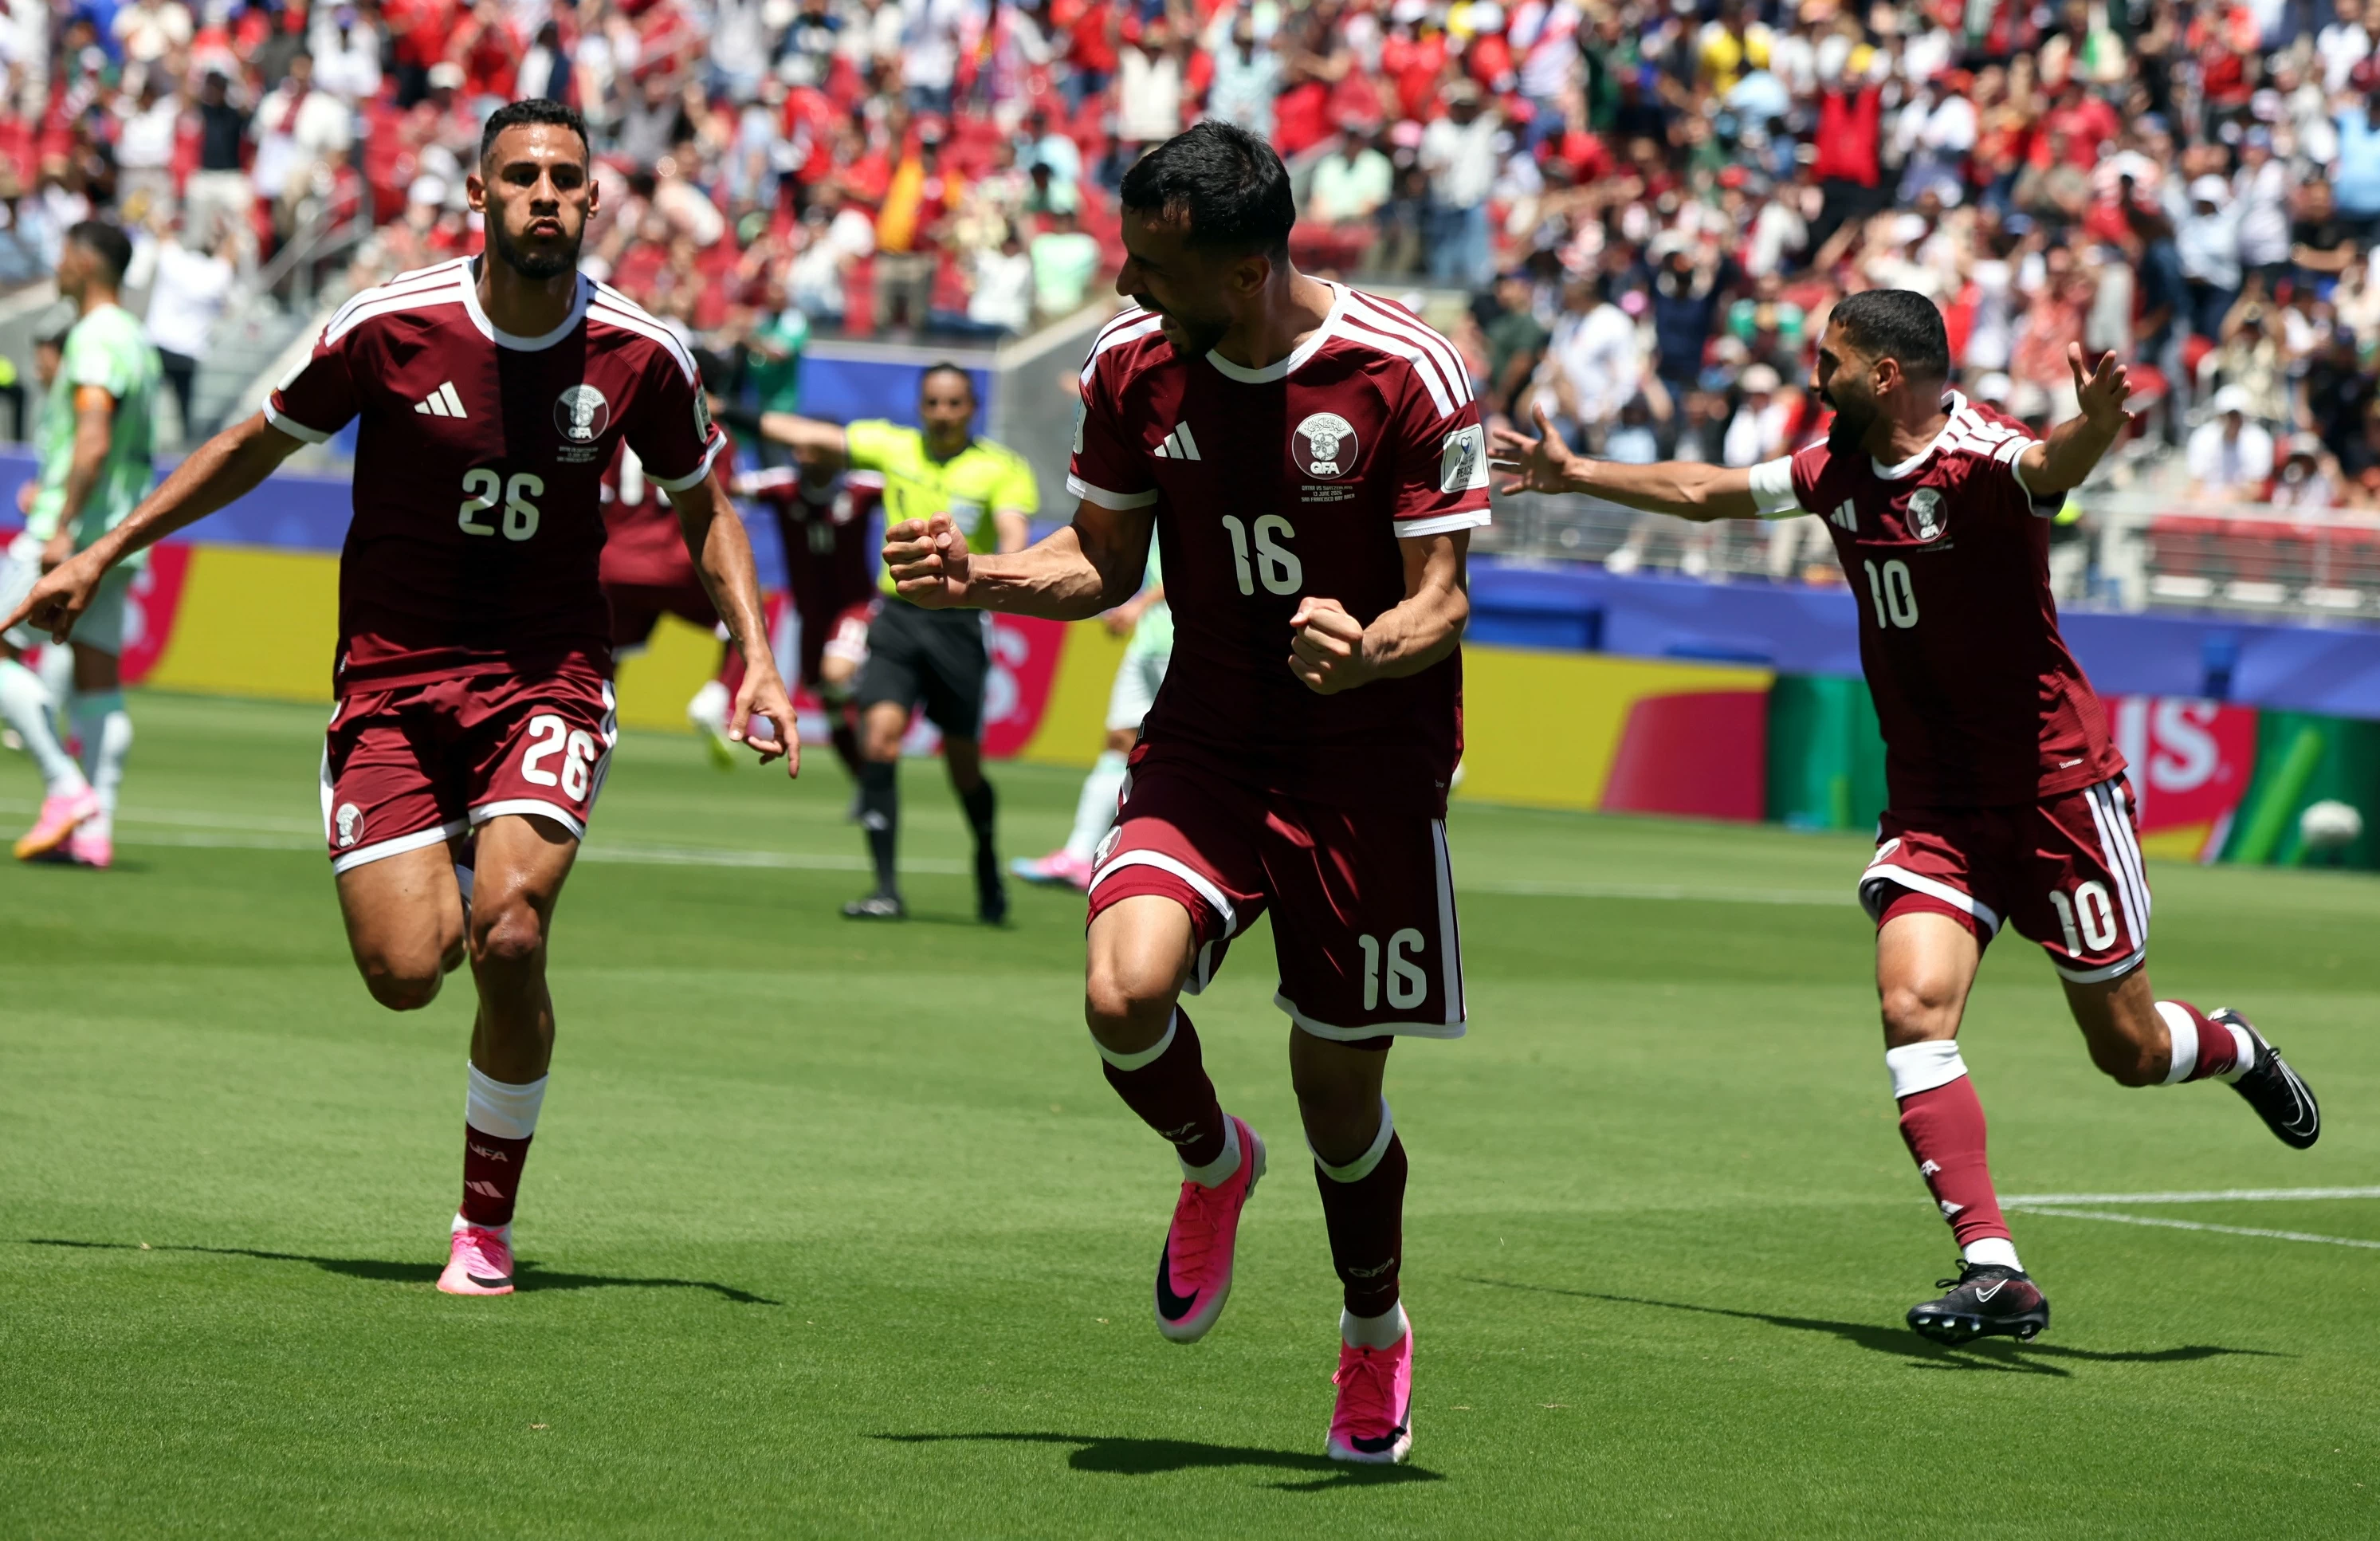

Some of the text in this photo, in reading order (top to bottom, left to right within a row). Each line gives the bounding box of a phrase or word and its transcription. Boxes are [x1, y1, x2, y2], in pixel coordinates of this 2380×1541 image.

[458, 468, 544, 541] 26
[1310, 462, 1340, 474] QFA
[1456, 464, 1473, 478] PEACE
[1222, 514, 1302, 596] 16
[1864, 559, 1919, 629] 10
[521, 714, 595, 802] 26
[2048, 879, 2118, 958] 10
[1358, 927, 1428, 1011] 16
